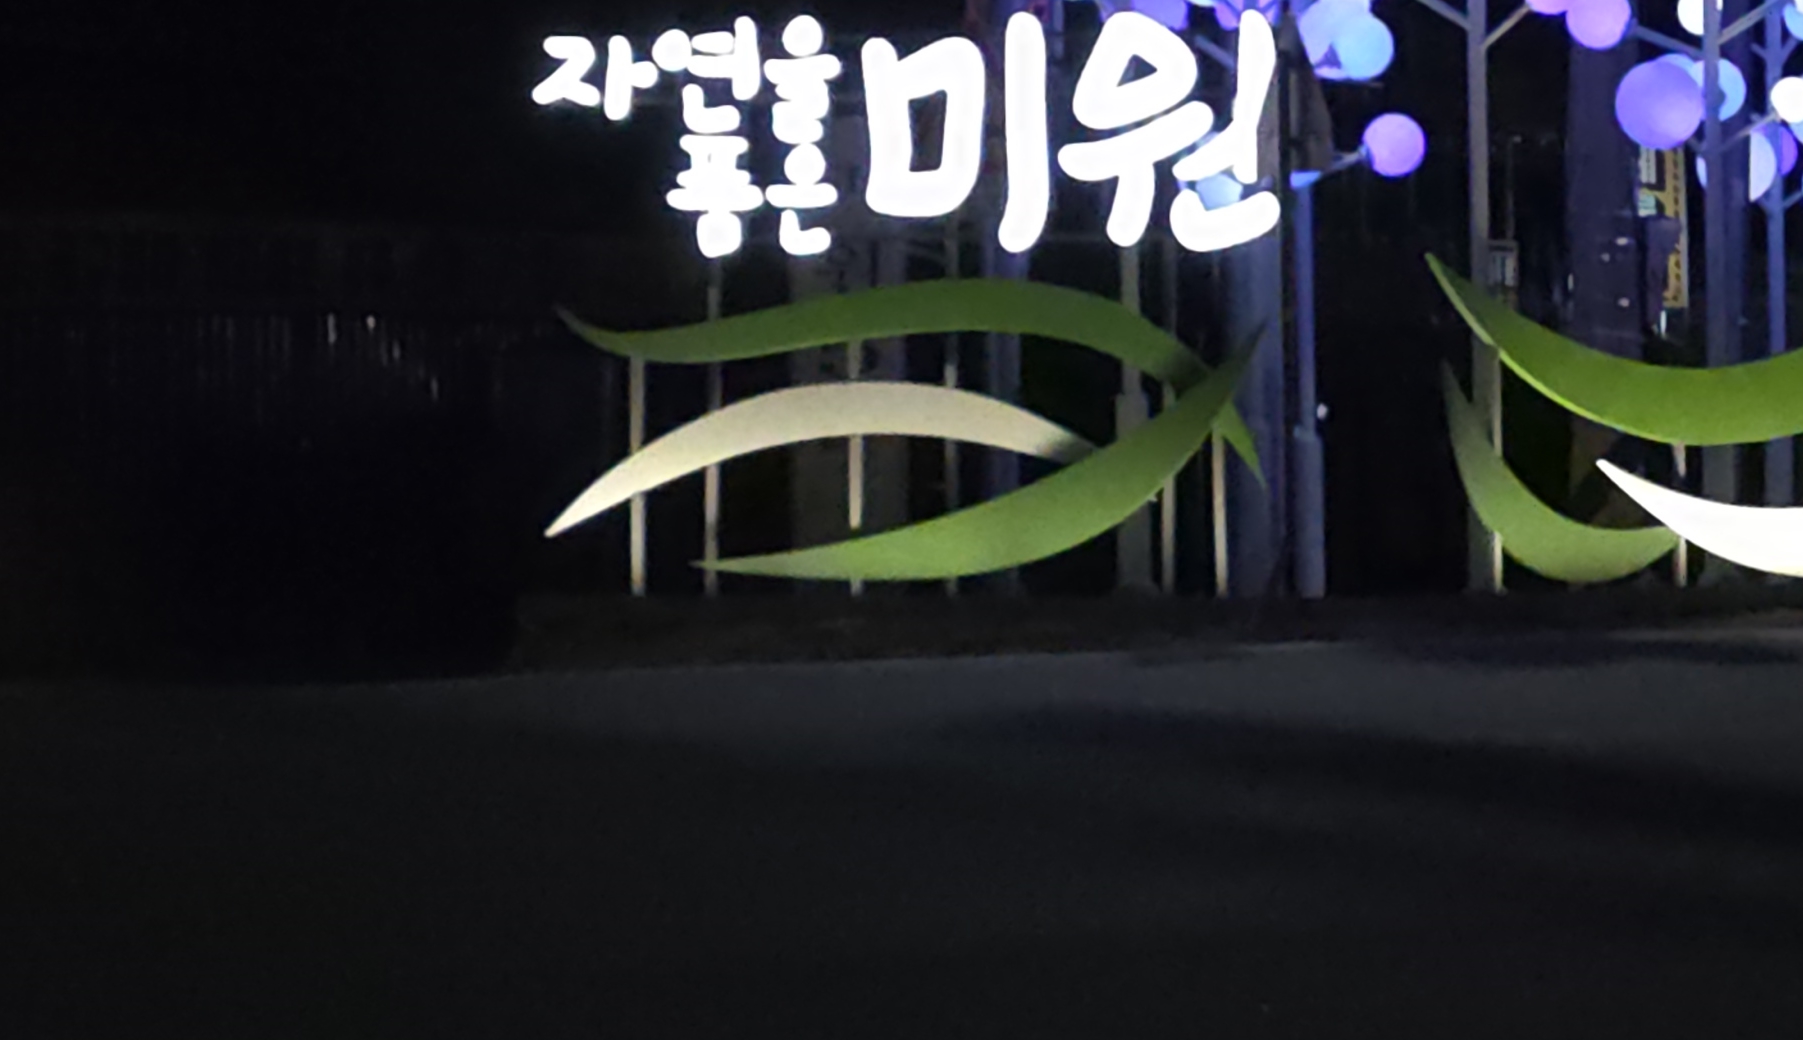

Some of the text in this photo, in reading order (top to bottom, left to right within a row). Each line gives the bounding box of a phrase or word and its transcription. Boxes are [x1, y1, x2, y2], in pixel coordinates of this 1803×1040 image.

[531, 14, 842, 144] 자연을
[860, 8, 1282, 253] 미원
[665, 133, 839, 259] 품은
